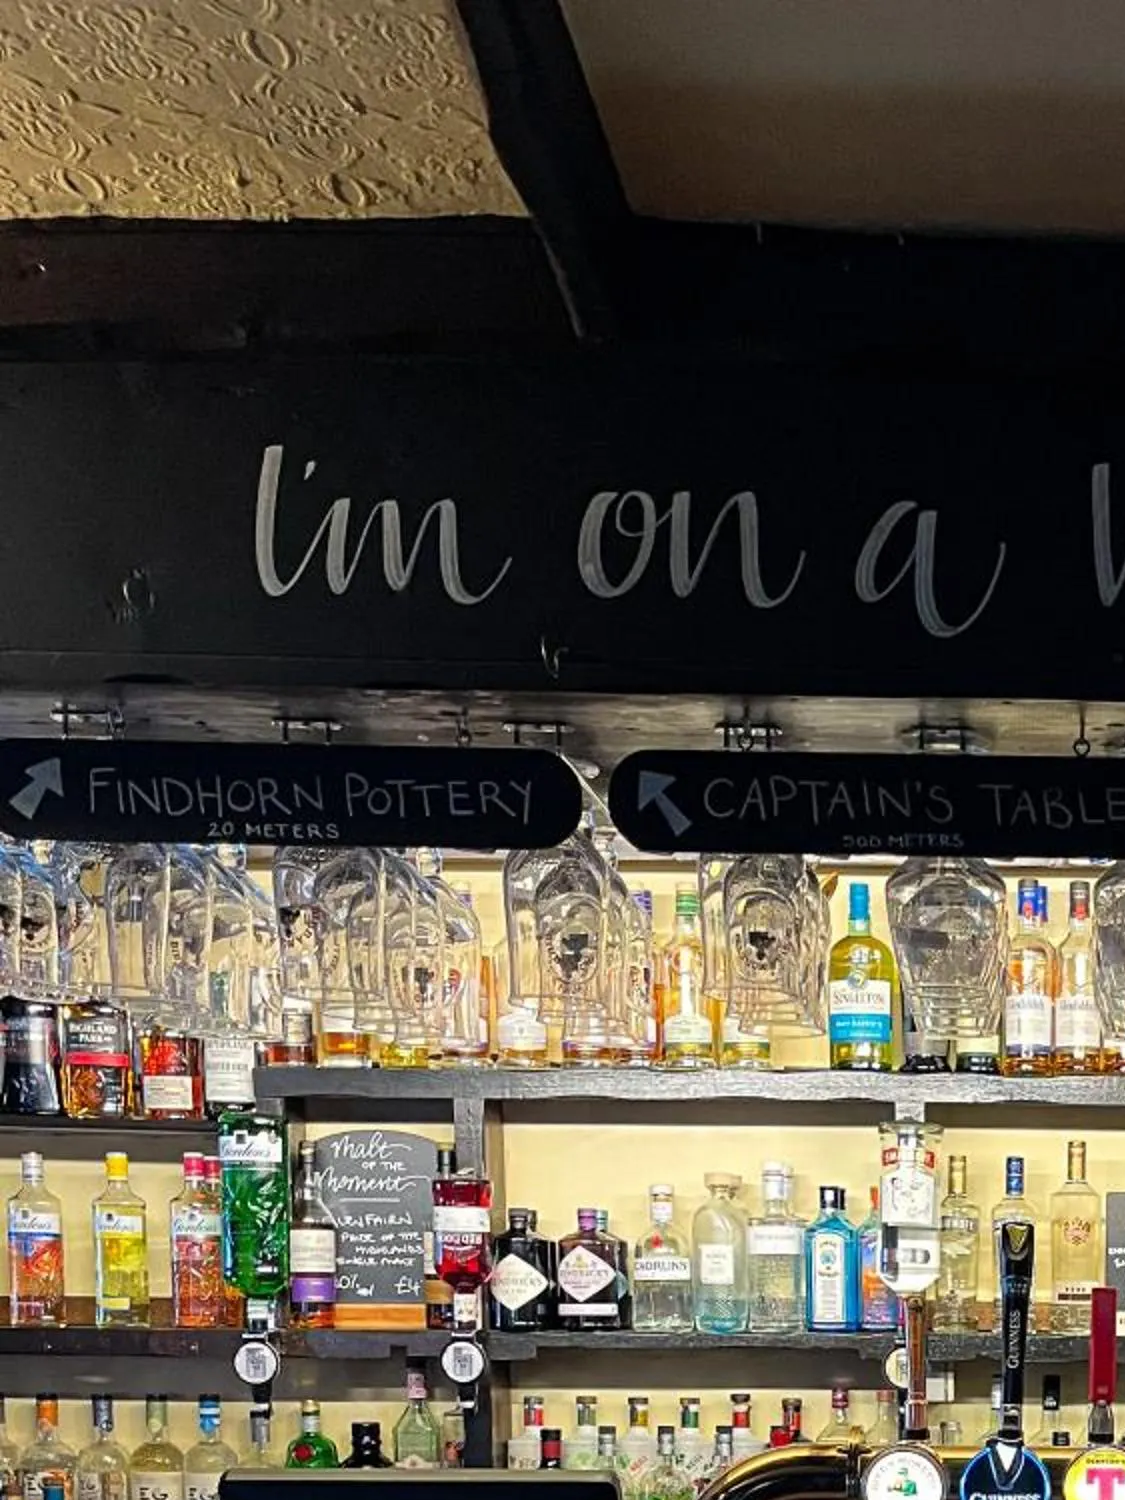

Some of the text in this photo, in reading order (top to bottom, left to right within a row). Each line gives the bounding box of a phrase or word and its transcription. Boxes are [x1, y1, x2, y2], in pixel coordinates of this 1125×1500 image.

[577, 490, 806, 608] on
[855, 501, 1005, 637] a
[88, 767, 533, 825] FINDHORN POTTERY
[703, 776, 955, 826] CAPTAIN'S
[208, 821, 340, 839] 20 METERS
[1006, 1310, 1021, 1370] GUINNESS
